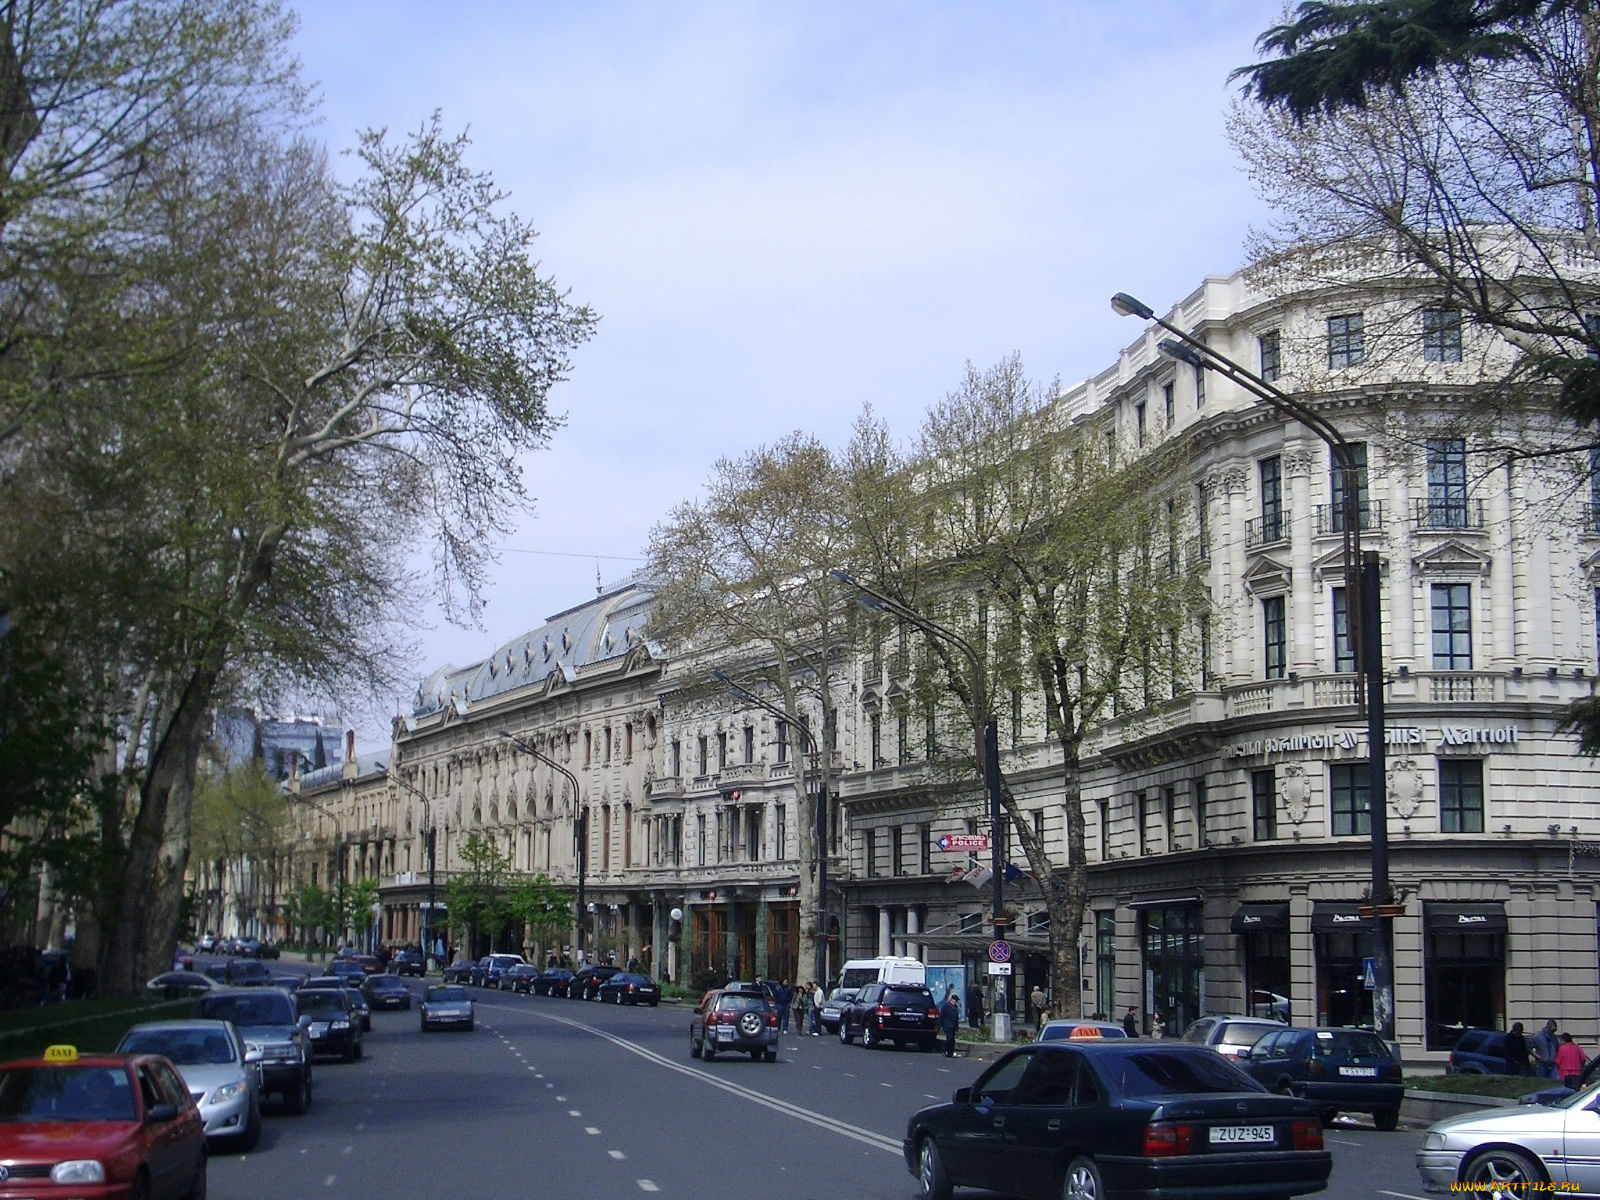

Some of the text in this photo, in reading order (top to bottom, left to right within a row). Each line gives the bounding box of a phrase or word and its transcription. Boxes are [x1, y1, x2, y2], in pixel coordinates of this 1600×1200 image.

[1436, 725, 1519, 747] Marriott
[1078, 1028, 1098, 1036] TAXI
[51, 1048, 72, 1056] TAXI
